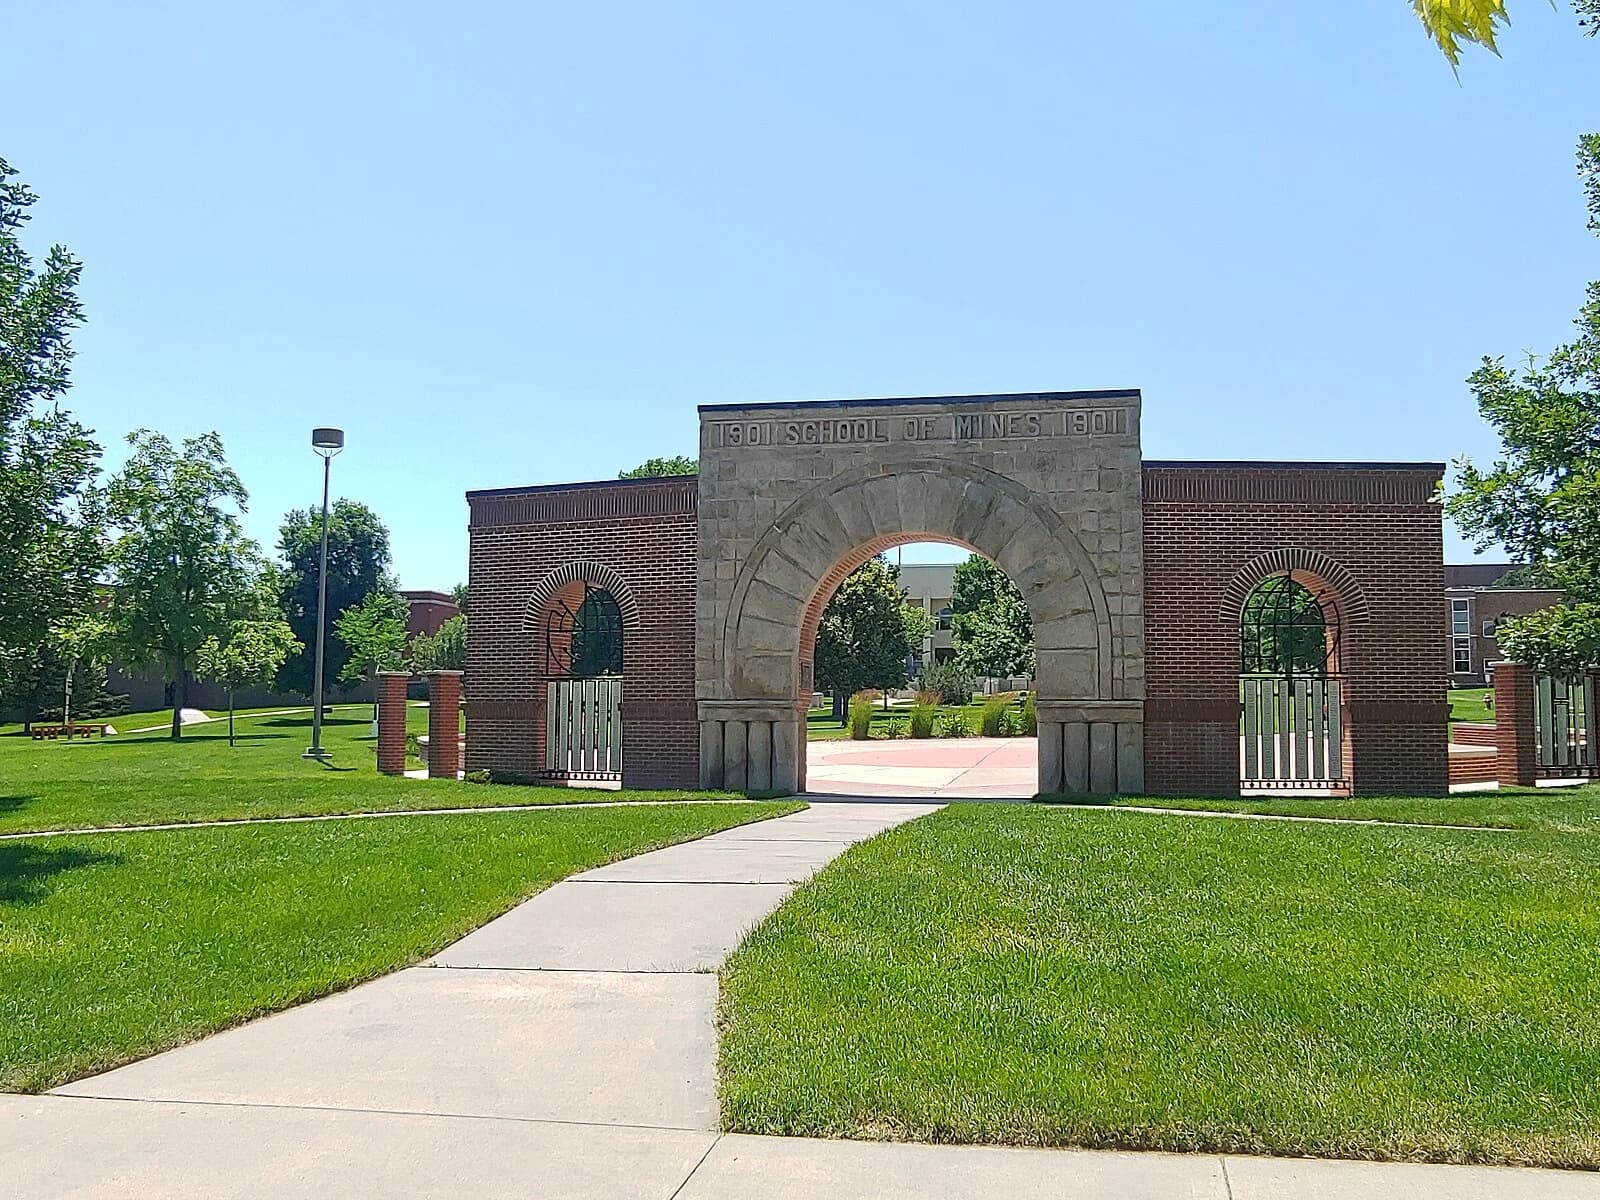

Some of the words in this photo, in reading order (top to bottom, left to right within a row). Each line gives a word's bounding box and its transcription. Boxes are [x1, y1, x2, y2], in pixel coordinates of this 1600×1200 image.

[718, 421, 771, 447] 1901
[785, 418, 887, 445] SCHOOL
[903, 416, 936, 441] OF
[956, 412, 1042, 439] MINES
[1062, 409, 1118, 436] 1901
